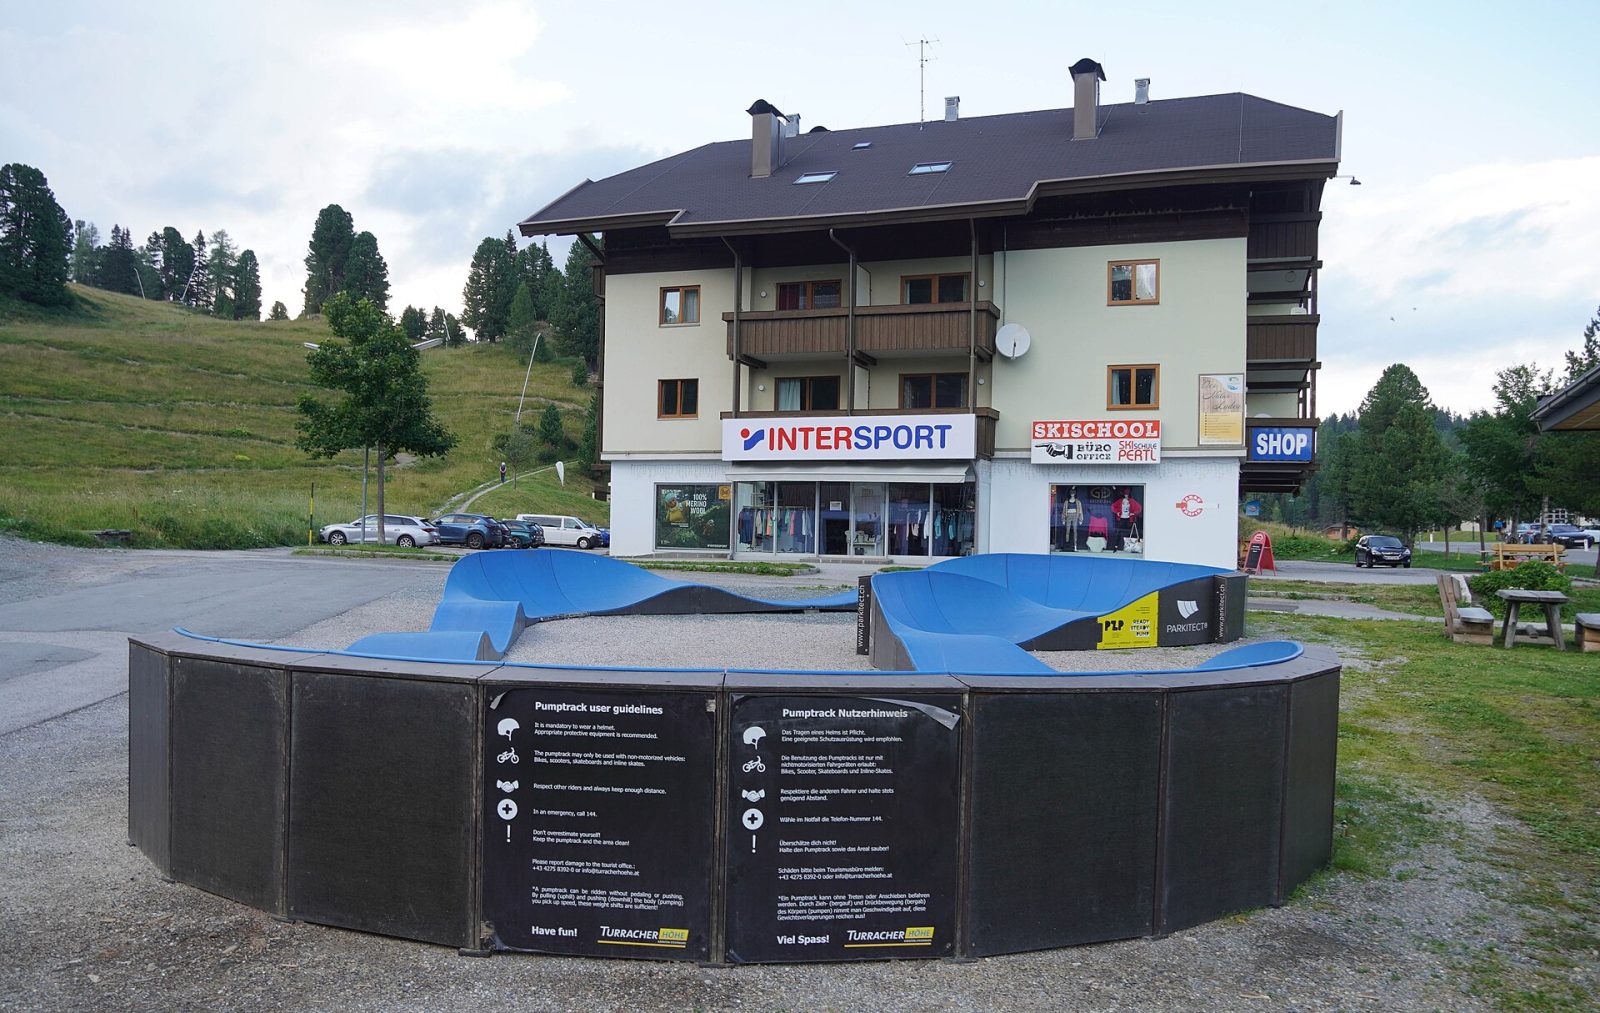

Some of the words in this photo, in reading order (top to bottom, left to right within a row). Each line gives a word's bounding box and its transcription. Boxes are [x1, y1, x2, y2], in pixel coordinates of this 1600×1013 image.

[1035, 423, 1158, 437] SKISCHOOL
[769, 425, 952, 451] INTERSPORT
[1077, 442, 1111, 452] BÜRO
[1256, 434, 1308, 455] SHOP
[1119, 450, 1156, 461] PERTL
[535, 702, 587, 713] Pumptrack
[613, 704, 663, 715] guidelines
[782, 709, 835, 719] Pumptrack
[838, 710, 908, 718] Nutzerhinweis
[532, 927, 556, 936] Have
[558, 928, 578, 936] fun!
[600, 926, 658, 940] TURRACHER
[662, 930, 684, 939] HÖHE
[847, 930, 904, 940] TURRACHER
[909, 929, 930, 937] HÖHE
[777, 936, 796, 944] Viel
[798, 935, 830, 945] Spass!
